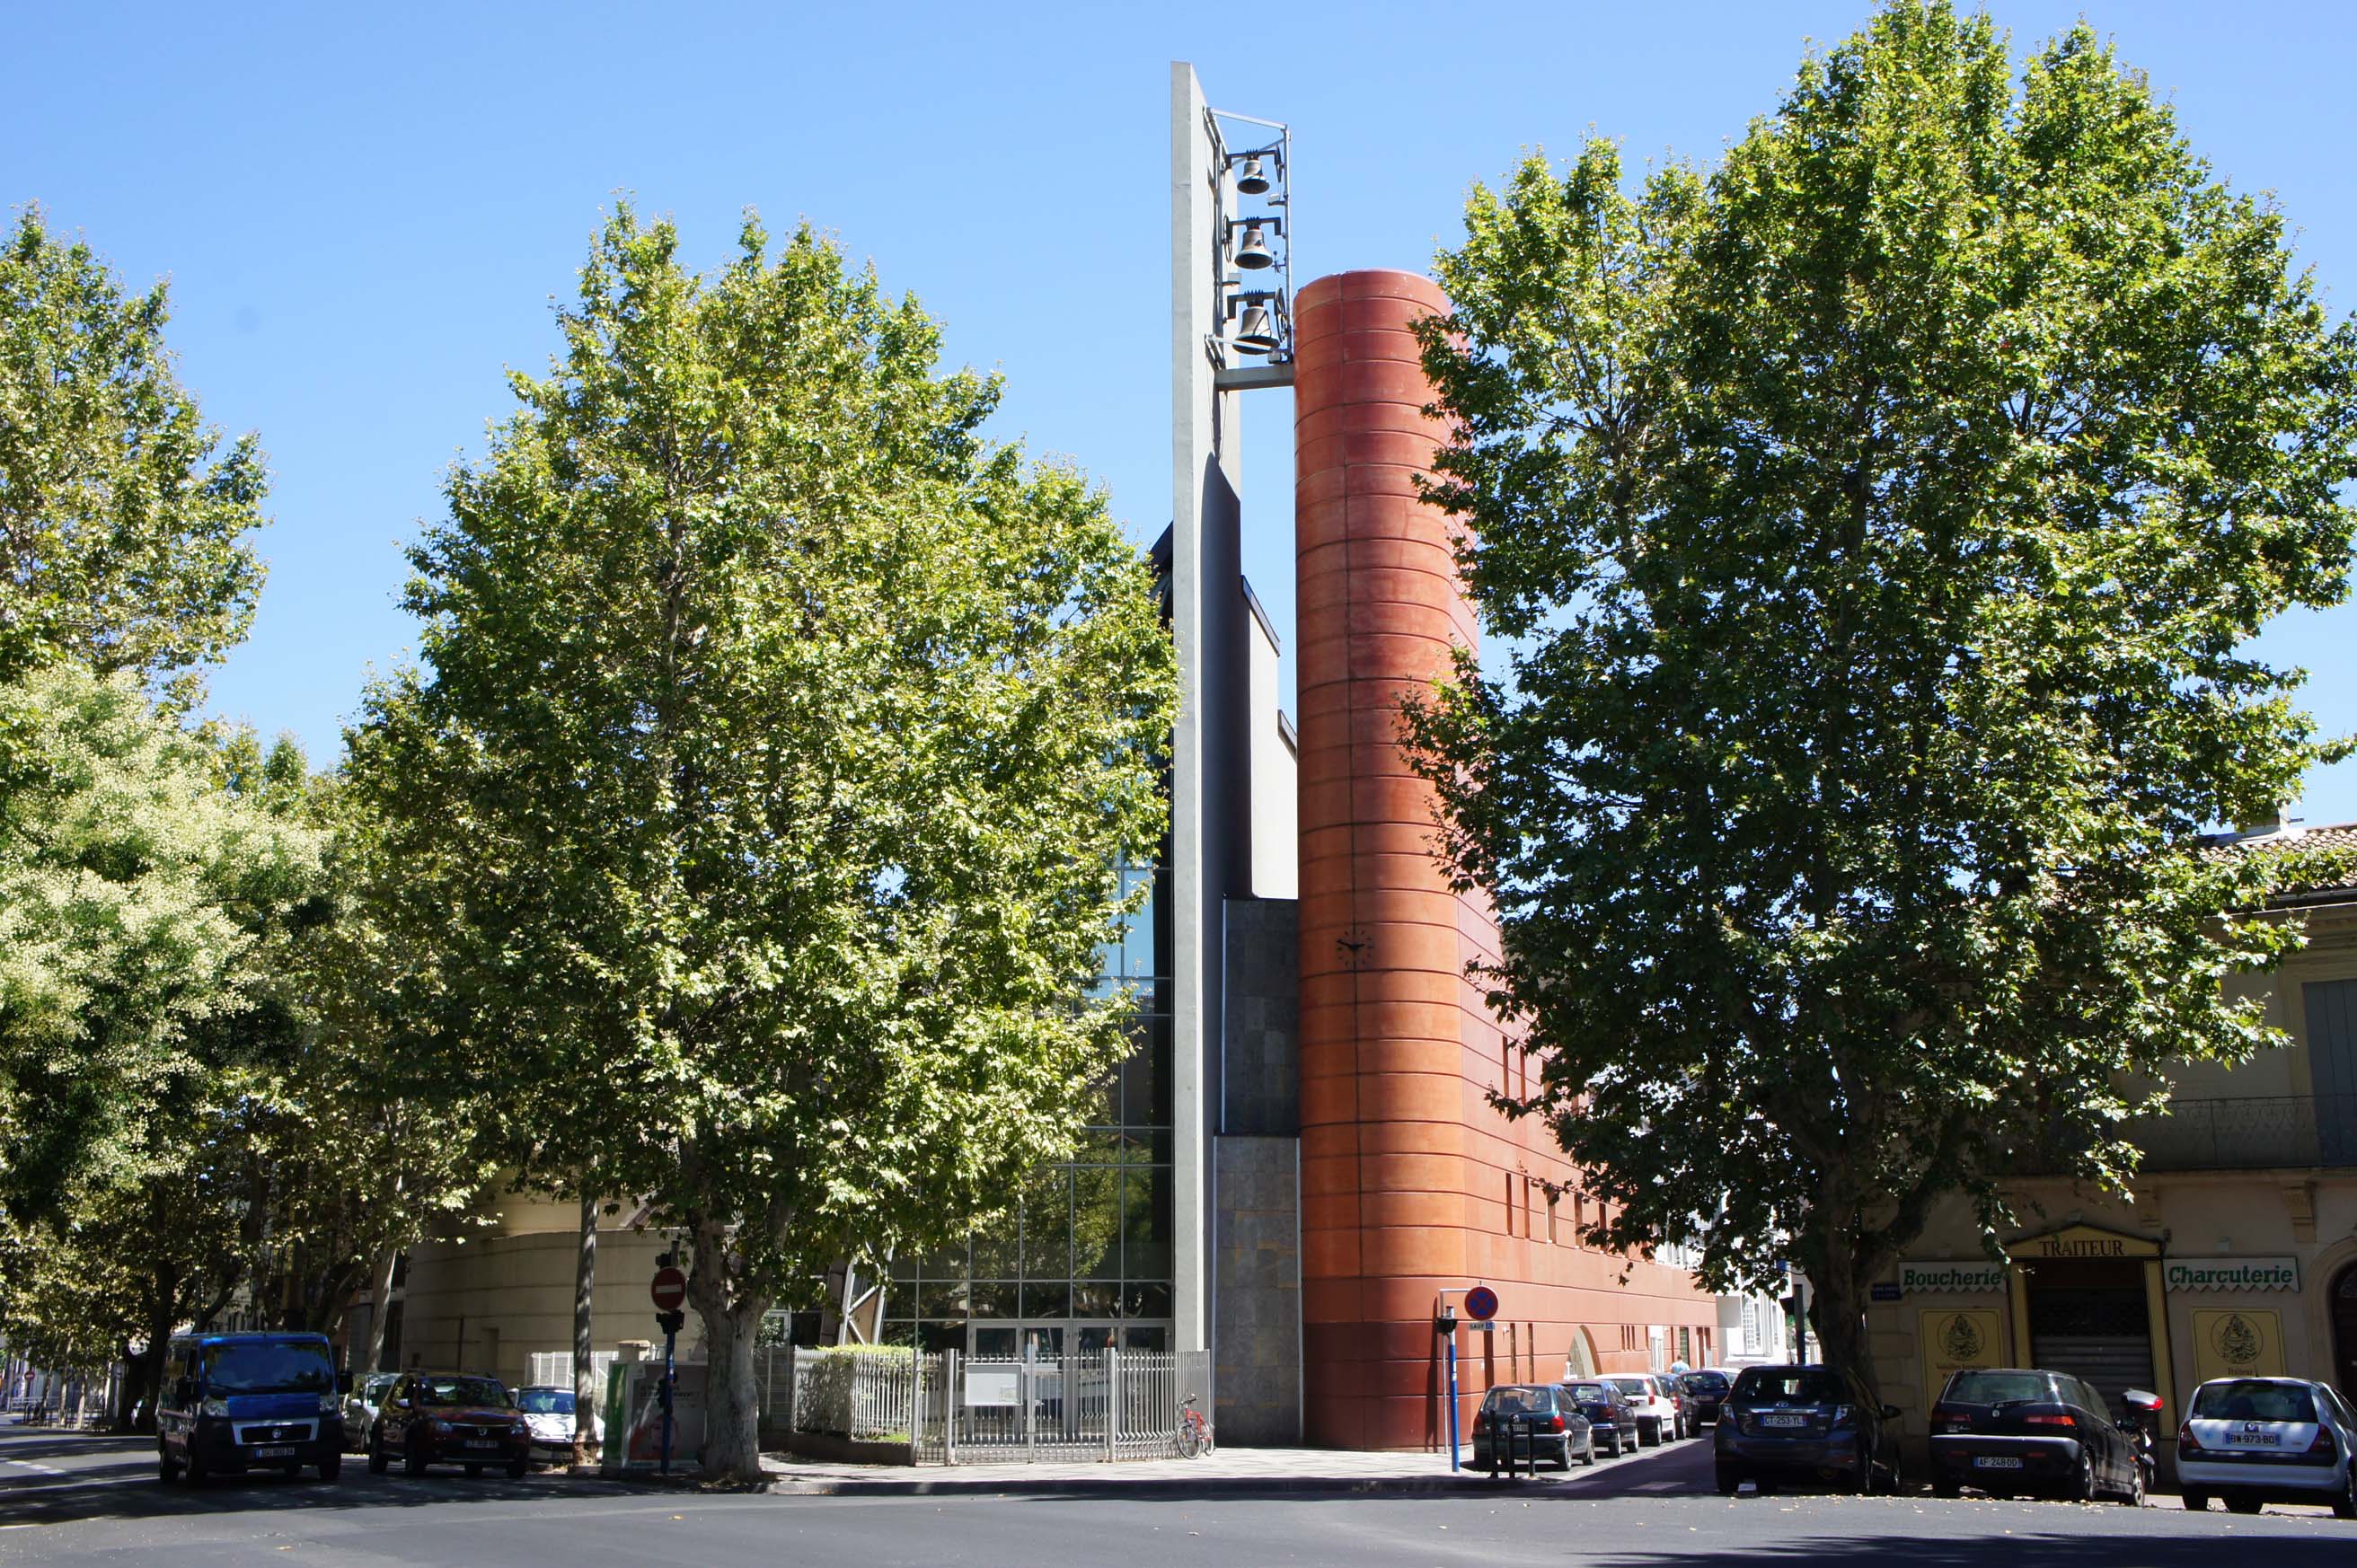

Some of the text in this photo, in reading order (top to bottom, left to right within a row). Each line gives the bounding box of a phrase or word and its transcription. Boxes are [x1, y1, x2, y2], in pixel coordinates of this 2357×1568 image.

[2039, 1240, 2125, 1256] TRAITEUR
[1903, 1268, 2001, 1286] Boucherie
[2168, 1264, 2293, 1283] Charcuterie
